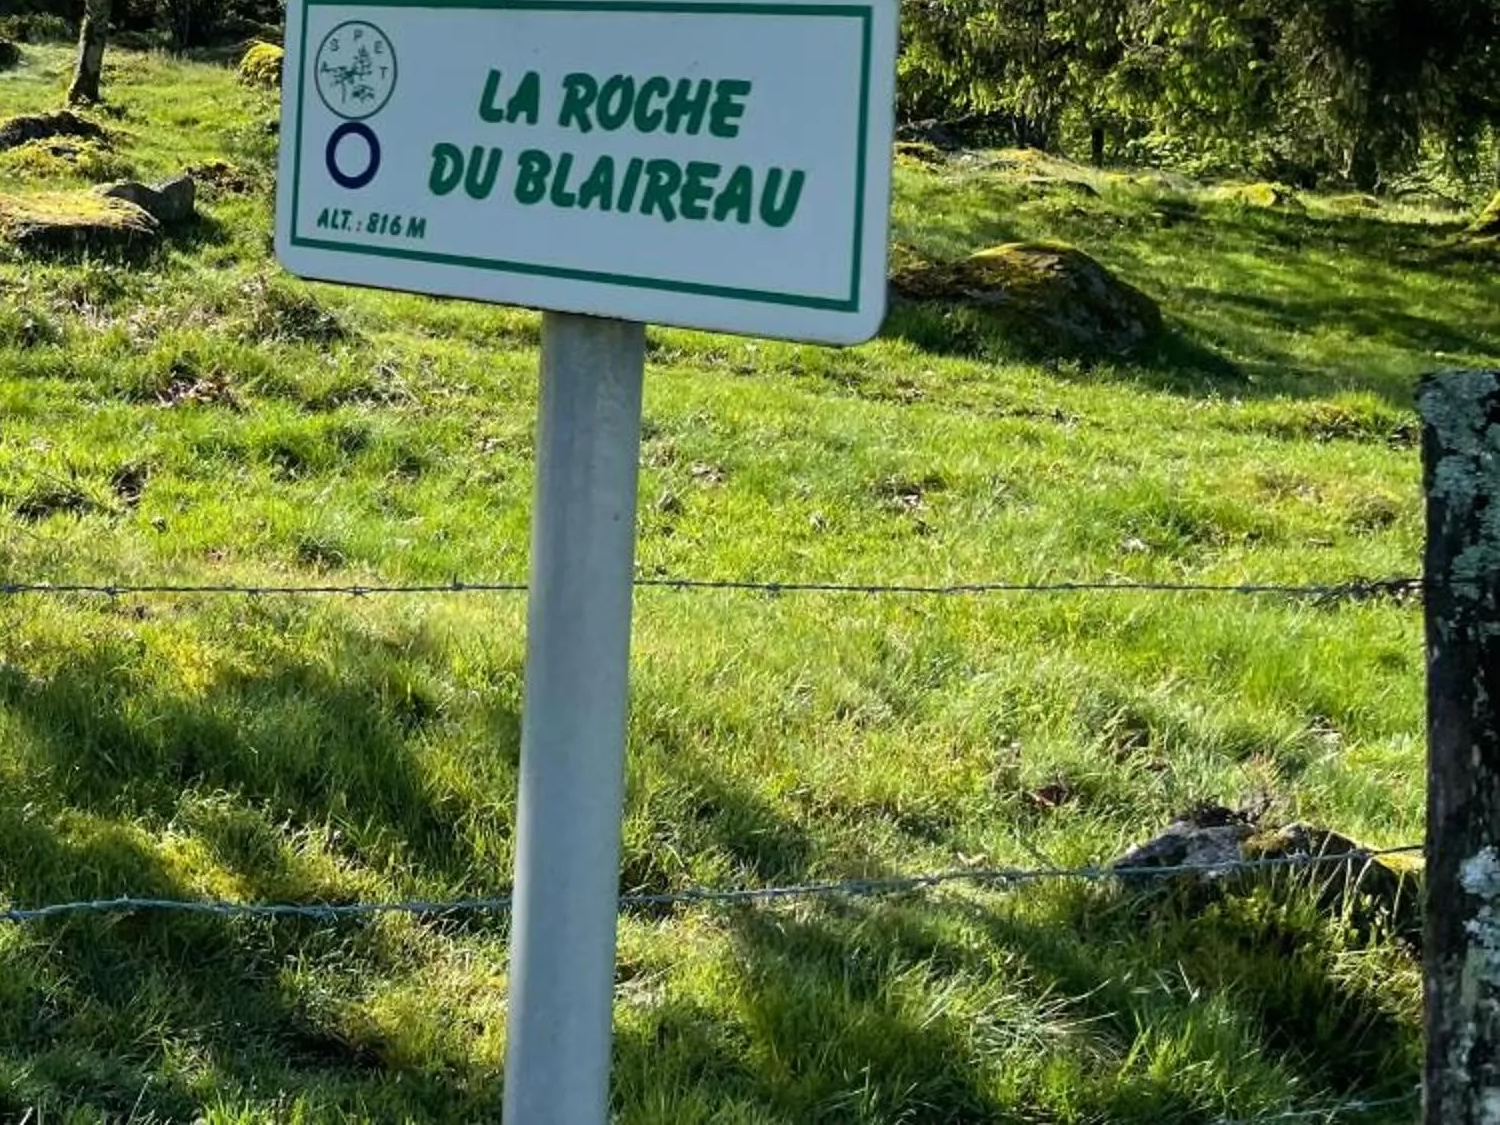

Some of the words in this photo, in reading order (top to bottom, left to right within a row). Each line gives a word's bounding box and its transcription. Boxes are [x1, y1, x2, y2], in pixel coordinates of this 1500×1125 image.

[477, 67, 541, 126] LA
[557, 71, 753, 140] ROCHE
[427, 142, 504, 201] DU
[513, 148, 807, 229] BLAIREAU
[365, 211, 403, 237] 816
[405, 216, 427, 240] M
